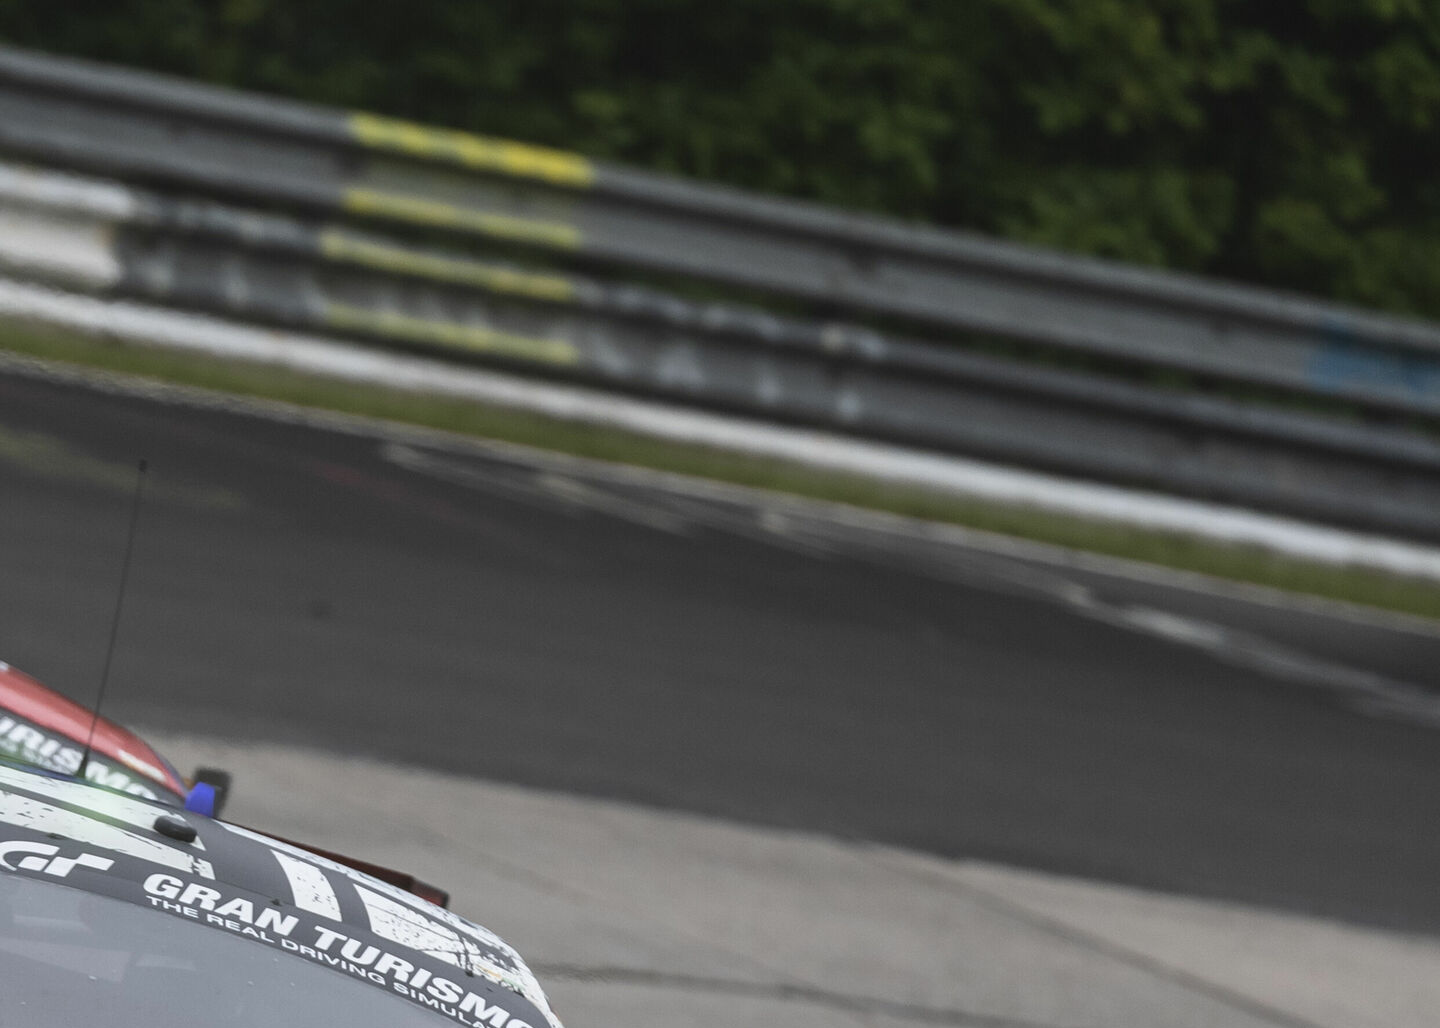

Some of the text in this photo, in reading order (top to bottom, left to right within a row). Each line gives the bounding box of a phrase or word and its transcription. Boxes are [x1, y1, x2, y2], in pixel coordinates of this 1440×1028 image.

[143, 873, 300, 937] GRAN
[146, 895, 200, 919] THE
[206, 913, 276, 944] REAL
[281, 938, 387, 986] DRIVING
